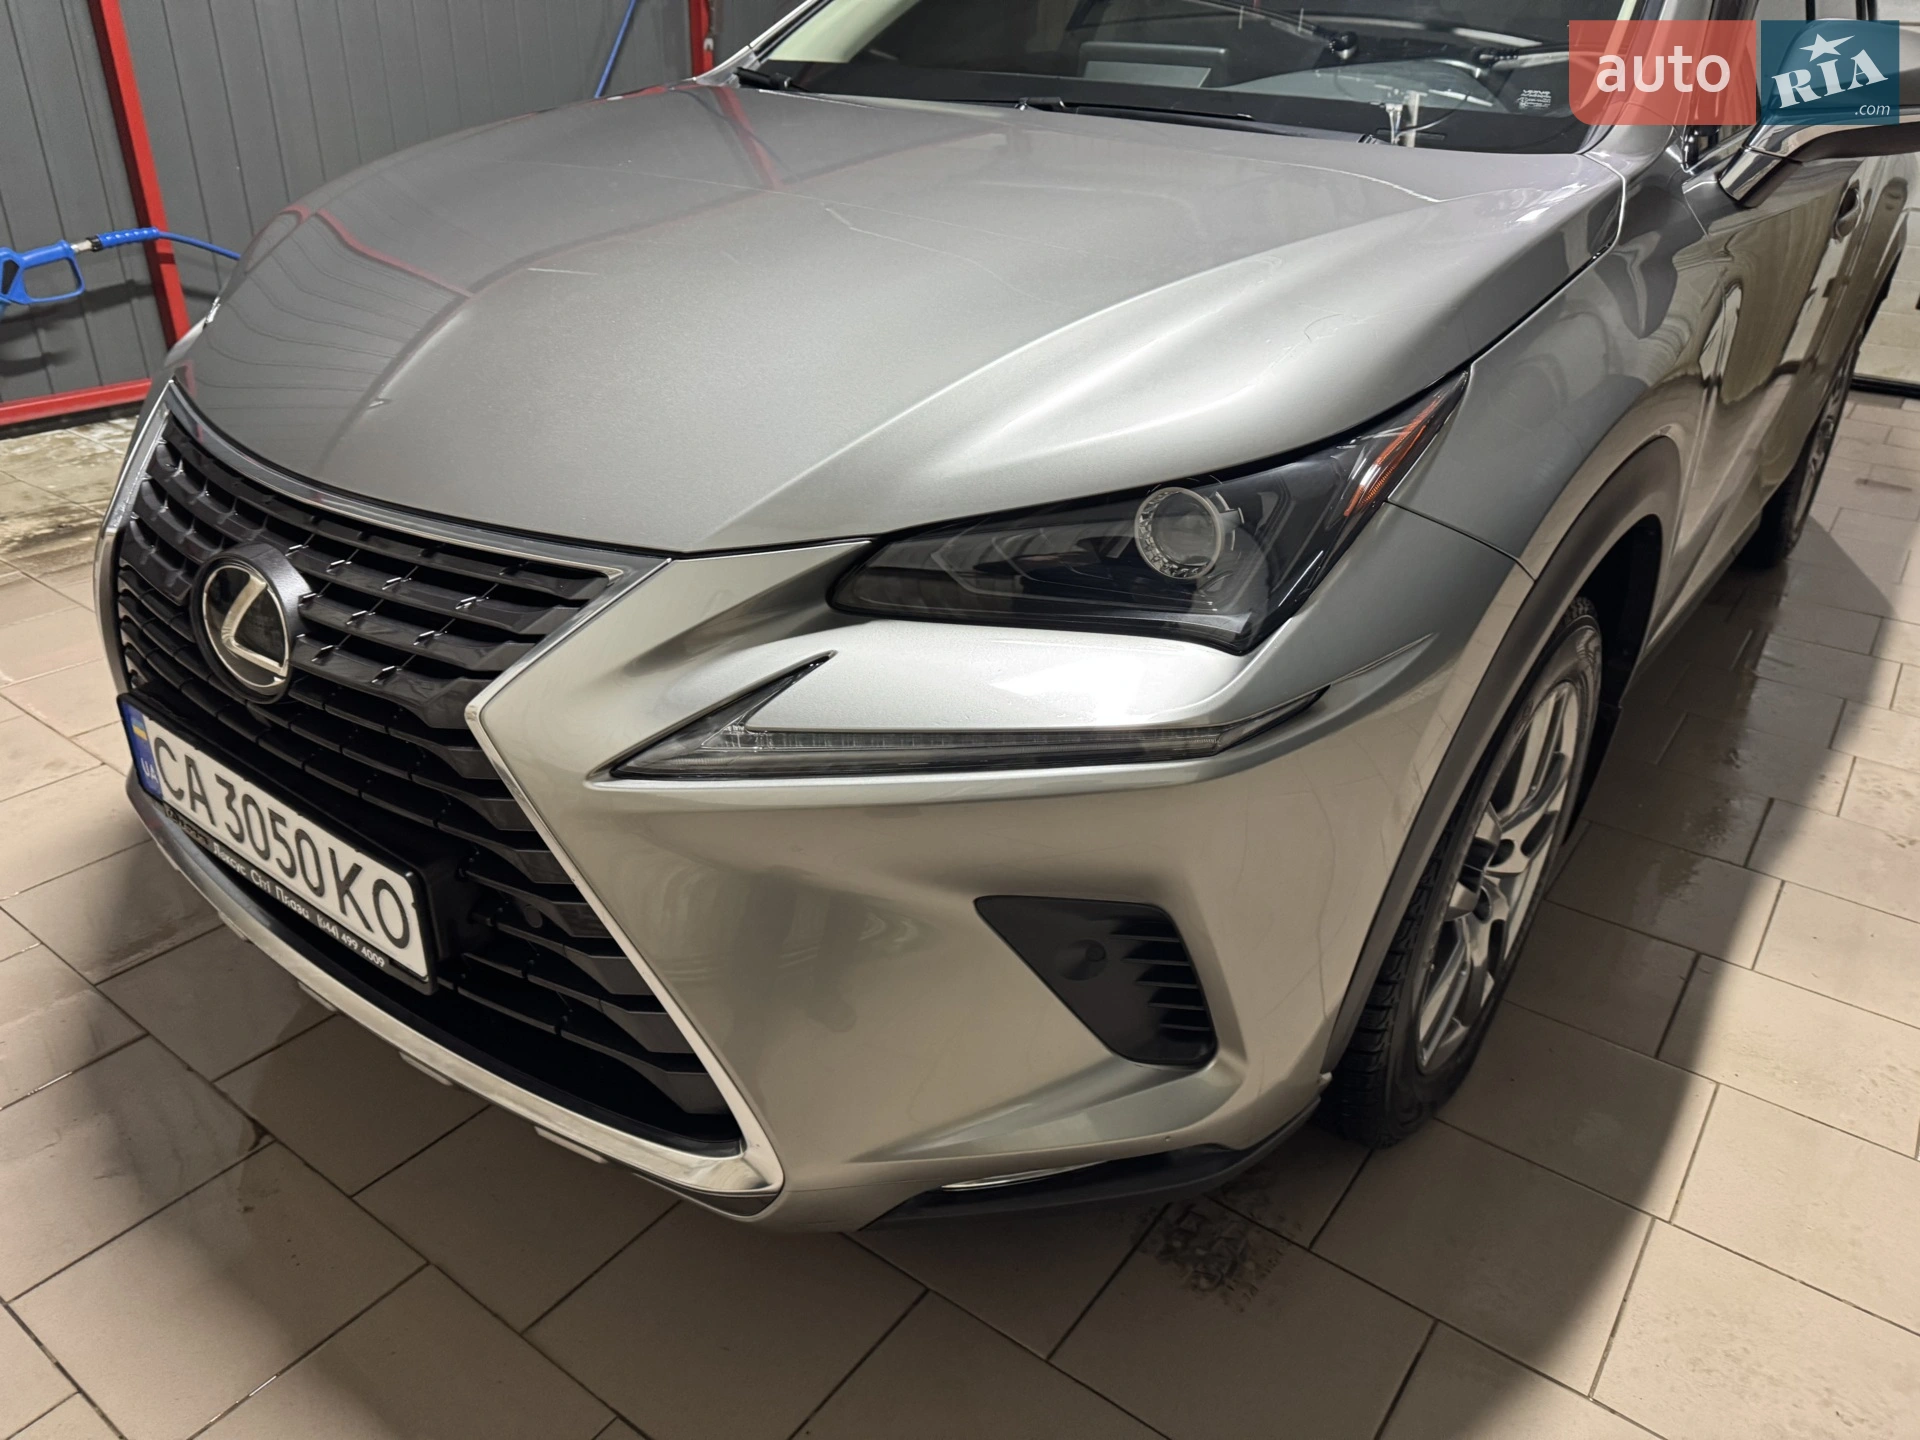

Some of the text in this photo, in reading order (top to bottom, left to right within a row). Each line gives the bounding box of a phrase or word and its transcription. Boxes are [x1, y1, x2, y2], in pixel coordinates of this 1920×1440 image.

[140, 757, 158, 784] UA
[341, 933, 359, 950] 499
[360, 946, 385, 968] 4009
